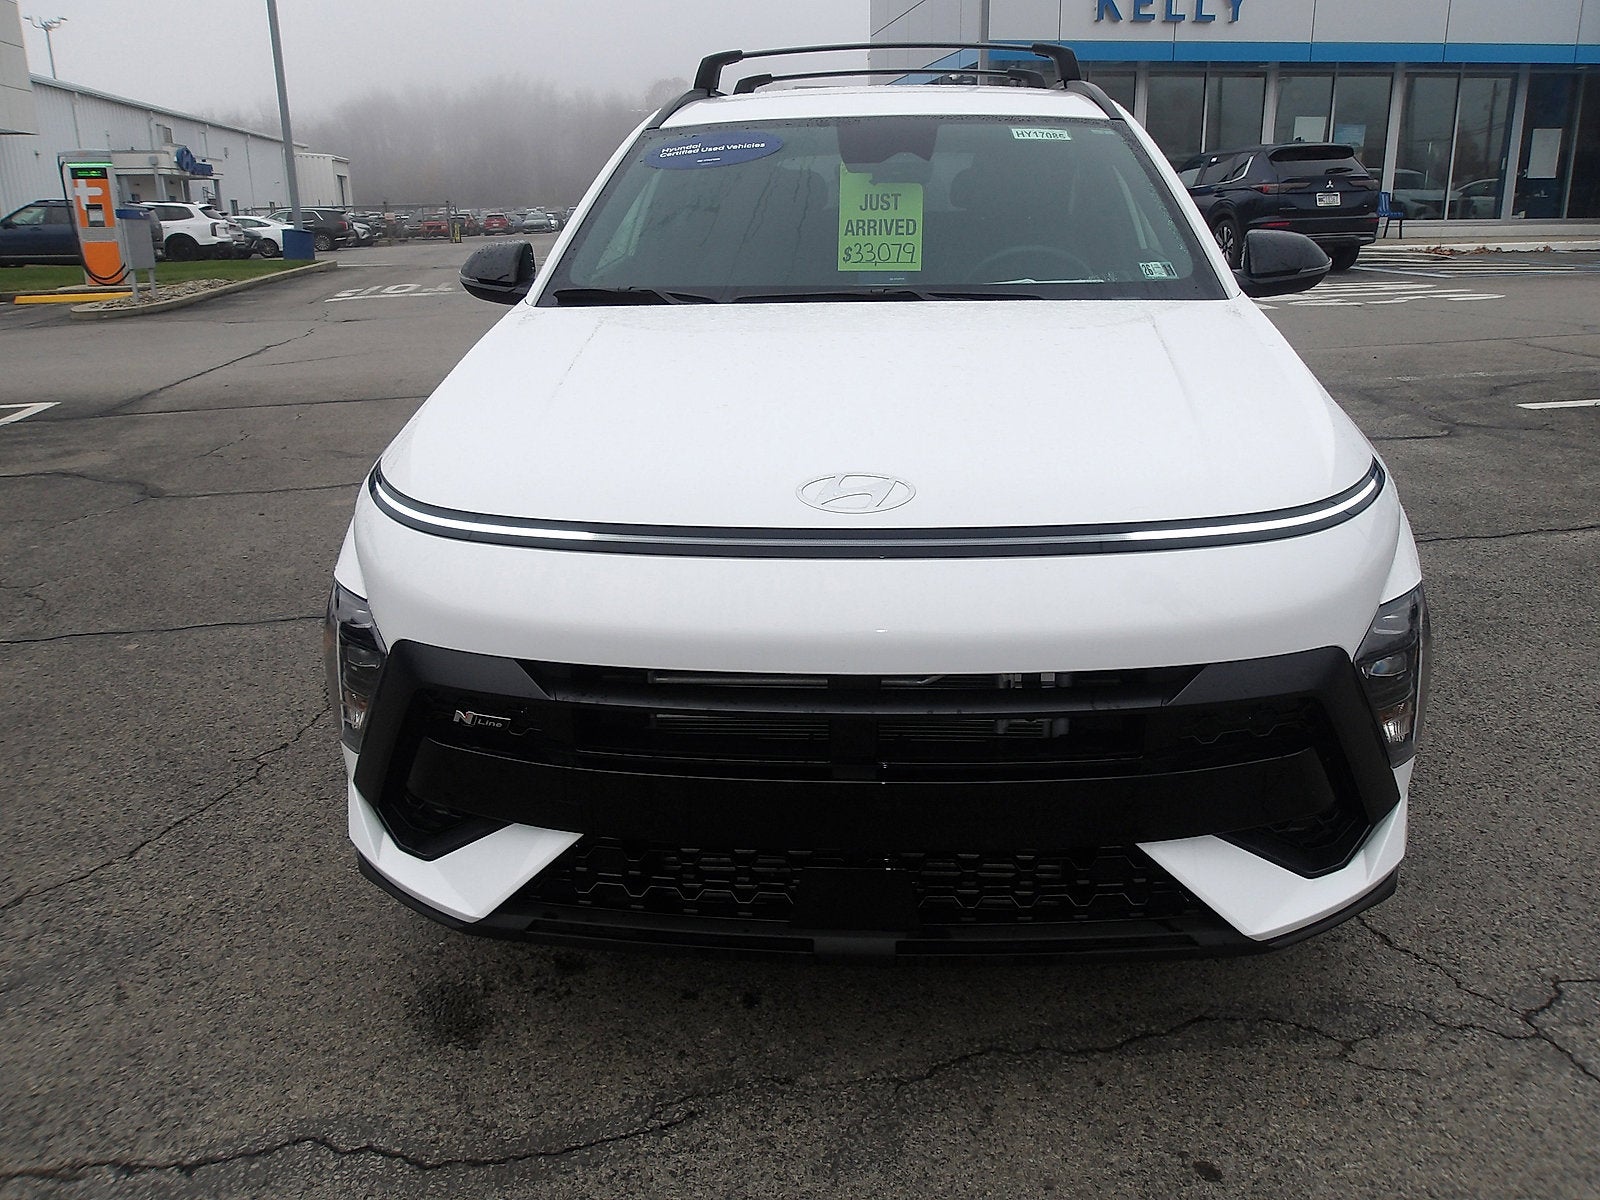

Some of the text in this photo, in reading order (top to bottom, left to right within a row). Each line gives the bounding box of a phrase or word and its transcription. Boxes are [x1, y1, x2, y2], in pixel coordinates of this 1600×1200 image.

[1095, 0, 1242, 22] KELLY
[660, 142, 766, 158] Certified Used Vehicles
[661, 143, 702, 154] Hyundai
[859, 193, 902, 211] JUST
[844, 218, 917, 236] ARRIVED
[843, 242, 917, 267] $33,079
[1141, 264, 1154, 276] 26
[1161, 264, 1176, 276] 11
[453, 709, 503, 728] N Line
